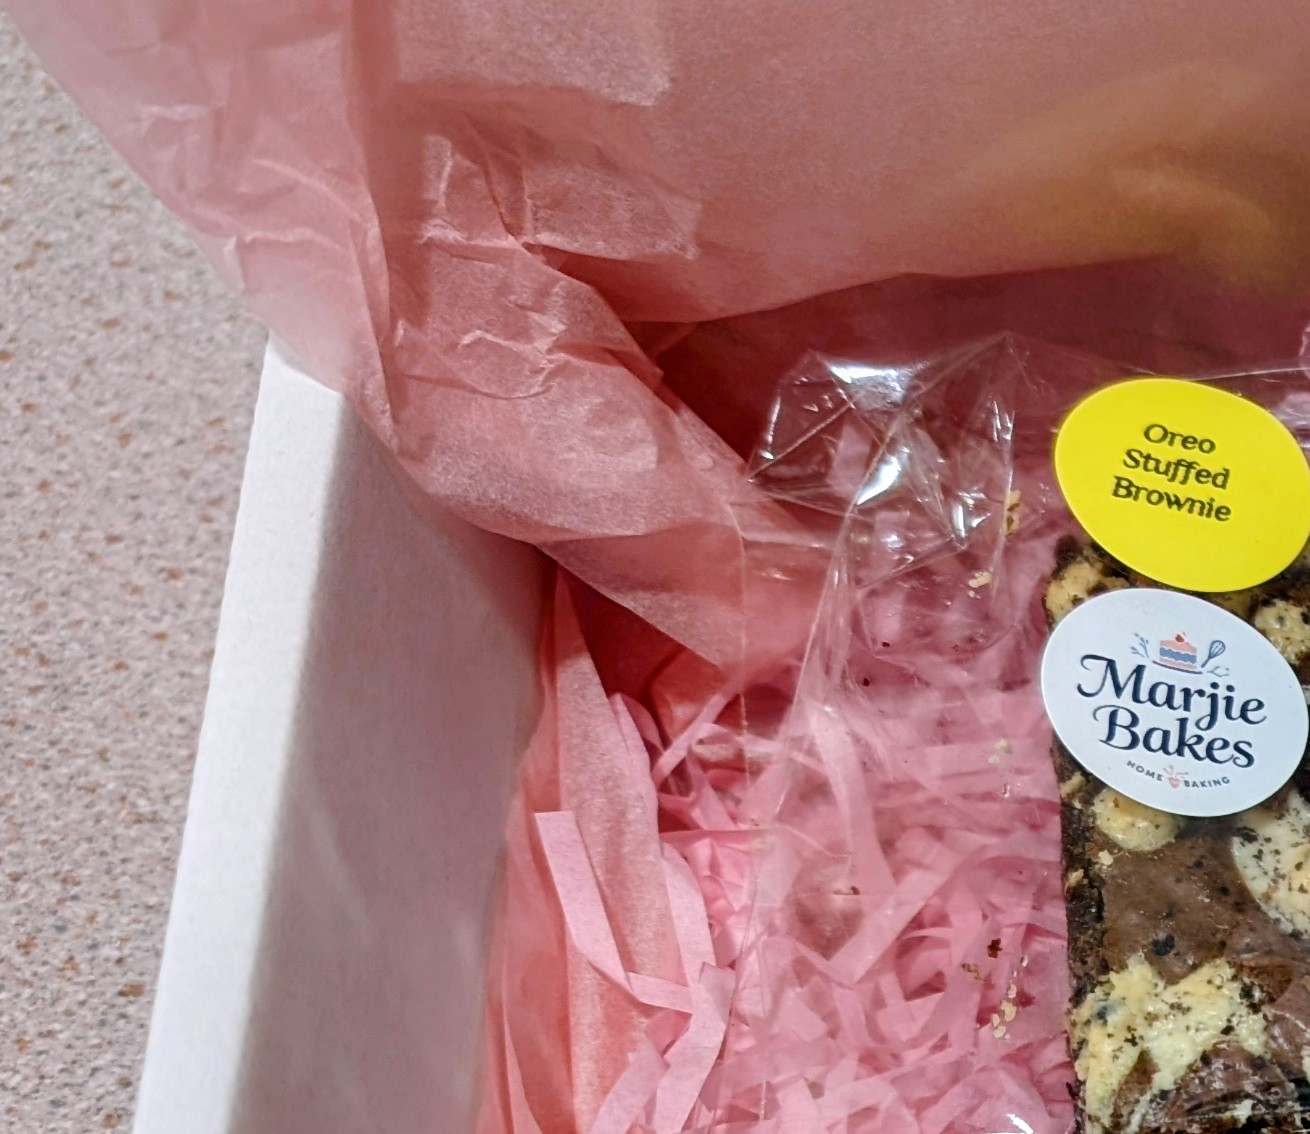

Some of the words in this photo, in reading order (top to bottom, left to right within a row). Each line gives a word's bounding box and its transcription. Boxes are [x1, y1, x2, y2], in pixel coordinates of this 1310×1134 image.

[1143, 424, 1217, 454] Oreo
[1123, 449, 1230, 490] Stuffed
[1111, 475, 1232, 522] Brownie
[1077, 654, 1268, 732] Marjie
[1092, 704, 1255, 769] Bakes
[1126, 760, 1163, 782] HOME
[1183, 776, 1231, 789] BAKING
